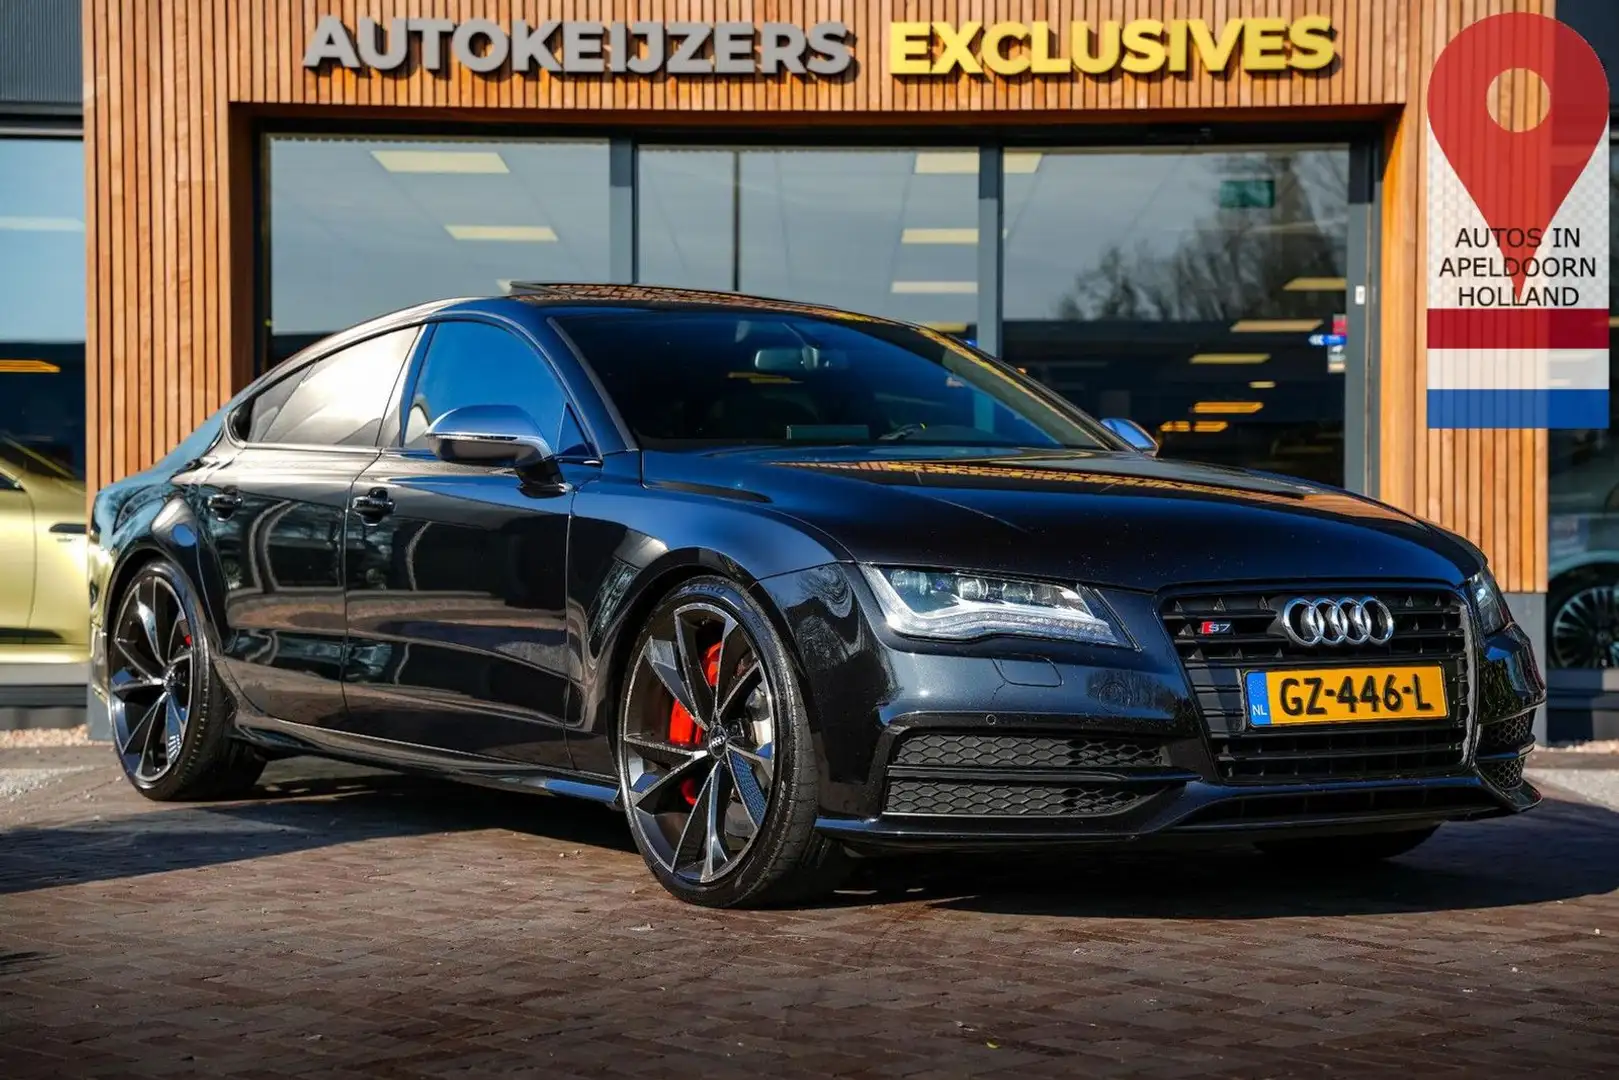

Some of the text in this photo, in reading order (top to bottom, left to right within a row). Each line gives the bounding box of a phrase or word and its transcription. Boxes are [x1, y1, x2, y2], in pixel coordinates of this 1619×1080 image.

[302, 15, 1336, 76] AUTOKEIJZERS EXCLUSIVES
[1207, 622, 1231, 633] S7
[1279, 674, 1432, 717] GZ-446-L
[1251, 704, 1268, 717] NL
